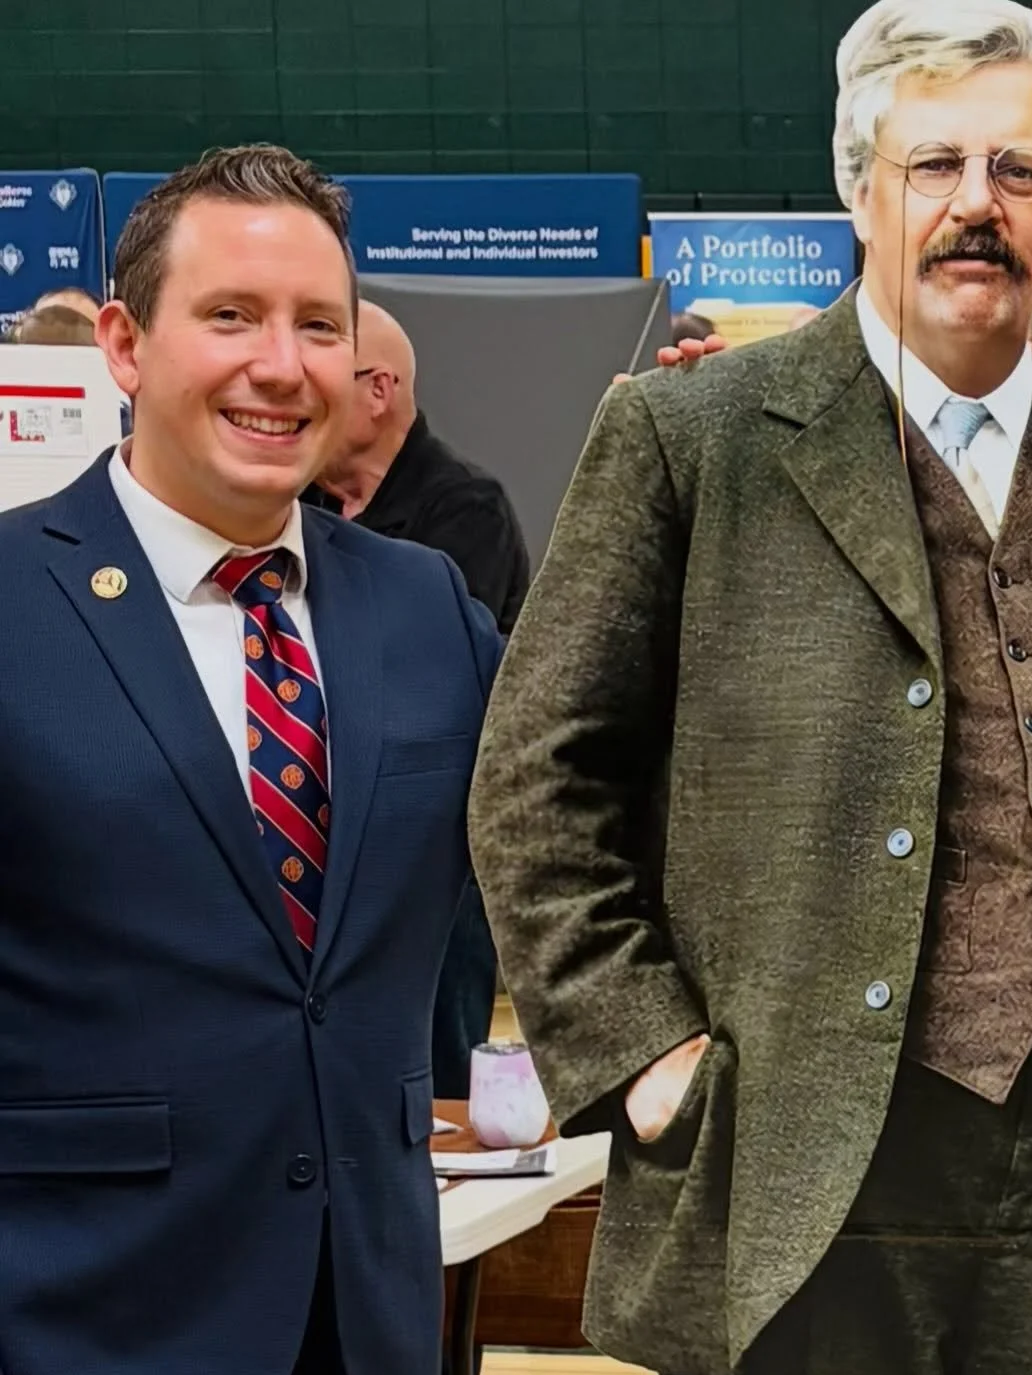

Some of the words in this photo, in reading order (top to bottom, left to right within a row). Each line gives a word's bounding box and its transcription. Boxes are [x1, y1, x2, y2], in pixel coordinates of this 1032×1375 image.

[412, 227, 461, 244] Serving
[464, 228, 485, 241] the
[488, 227, 537, 241] Diverse
[540, 227, 581, 240] Needs
[584, 226, 598, 239] of
[367, 246, 443, 260] Institutional
[446, 246, 470, 259] and
[473, 246, 536, 259] Individual
[539, 246, 598, 259] Investors
[676, 237, 695, 259] A
[703, 235, 822, 259] Portfolio
[666, 262, 692, 286] of
[701, 263, 841, 287] Protection
